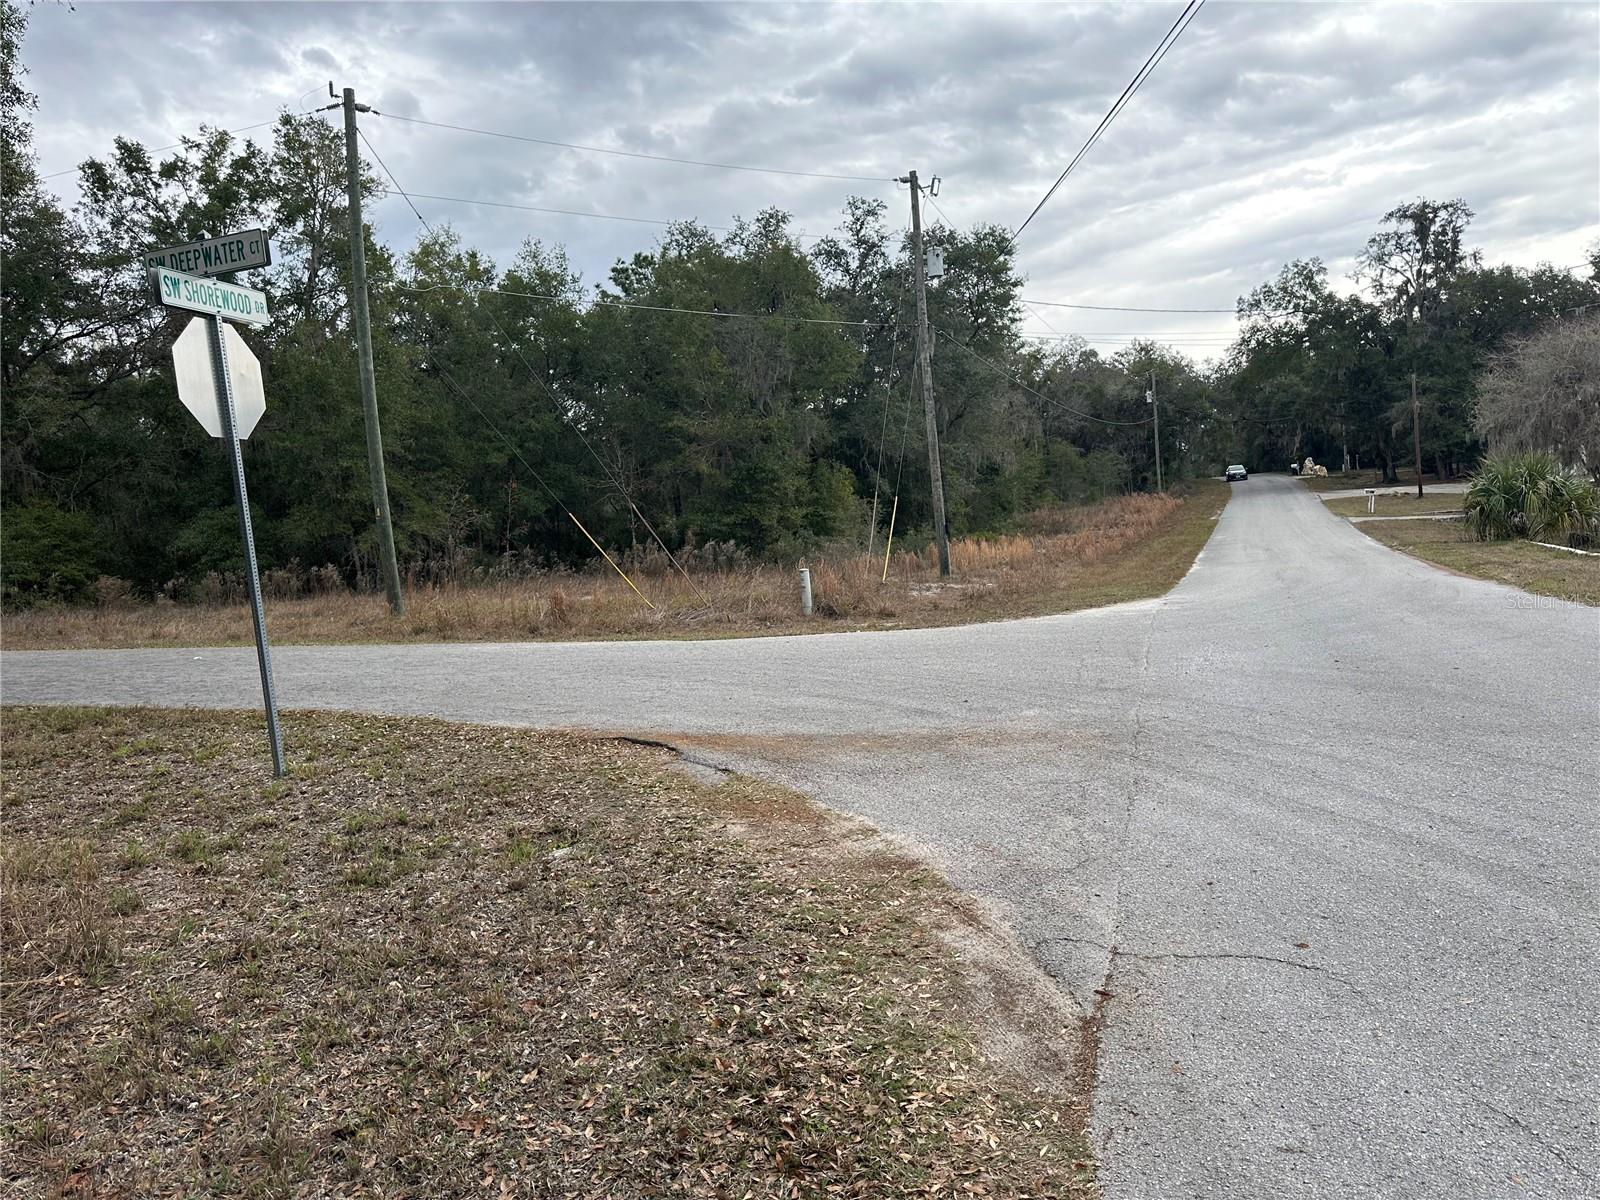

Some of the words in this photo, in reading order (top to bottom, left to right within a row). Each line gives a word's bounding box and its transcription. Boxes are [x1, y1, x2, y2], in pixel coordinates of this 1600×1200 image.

[148, 256, 166, 268] SW
[169, 240, 246, 272] DEEPWATER
[249, 240, 260, 255] CT
[163, 274, 180, 299] SW
[183, 279, 252, 315] SHOREWOOD
[254, 301, 266, 315] DR
